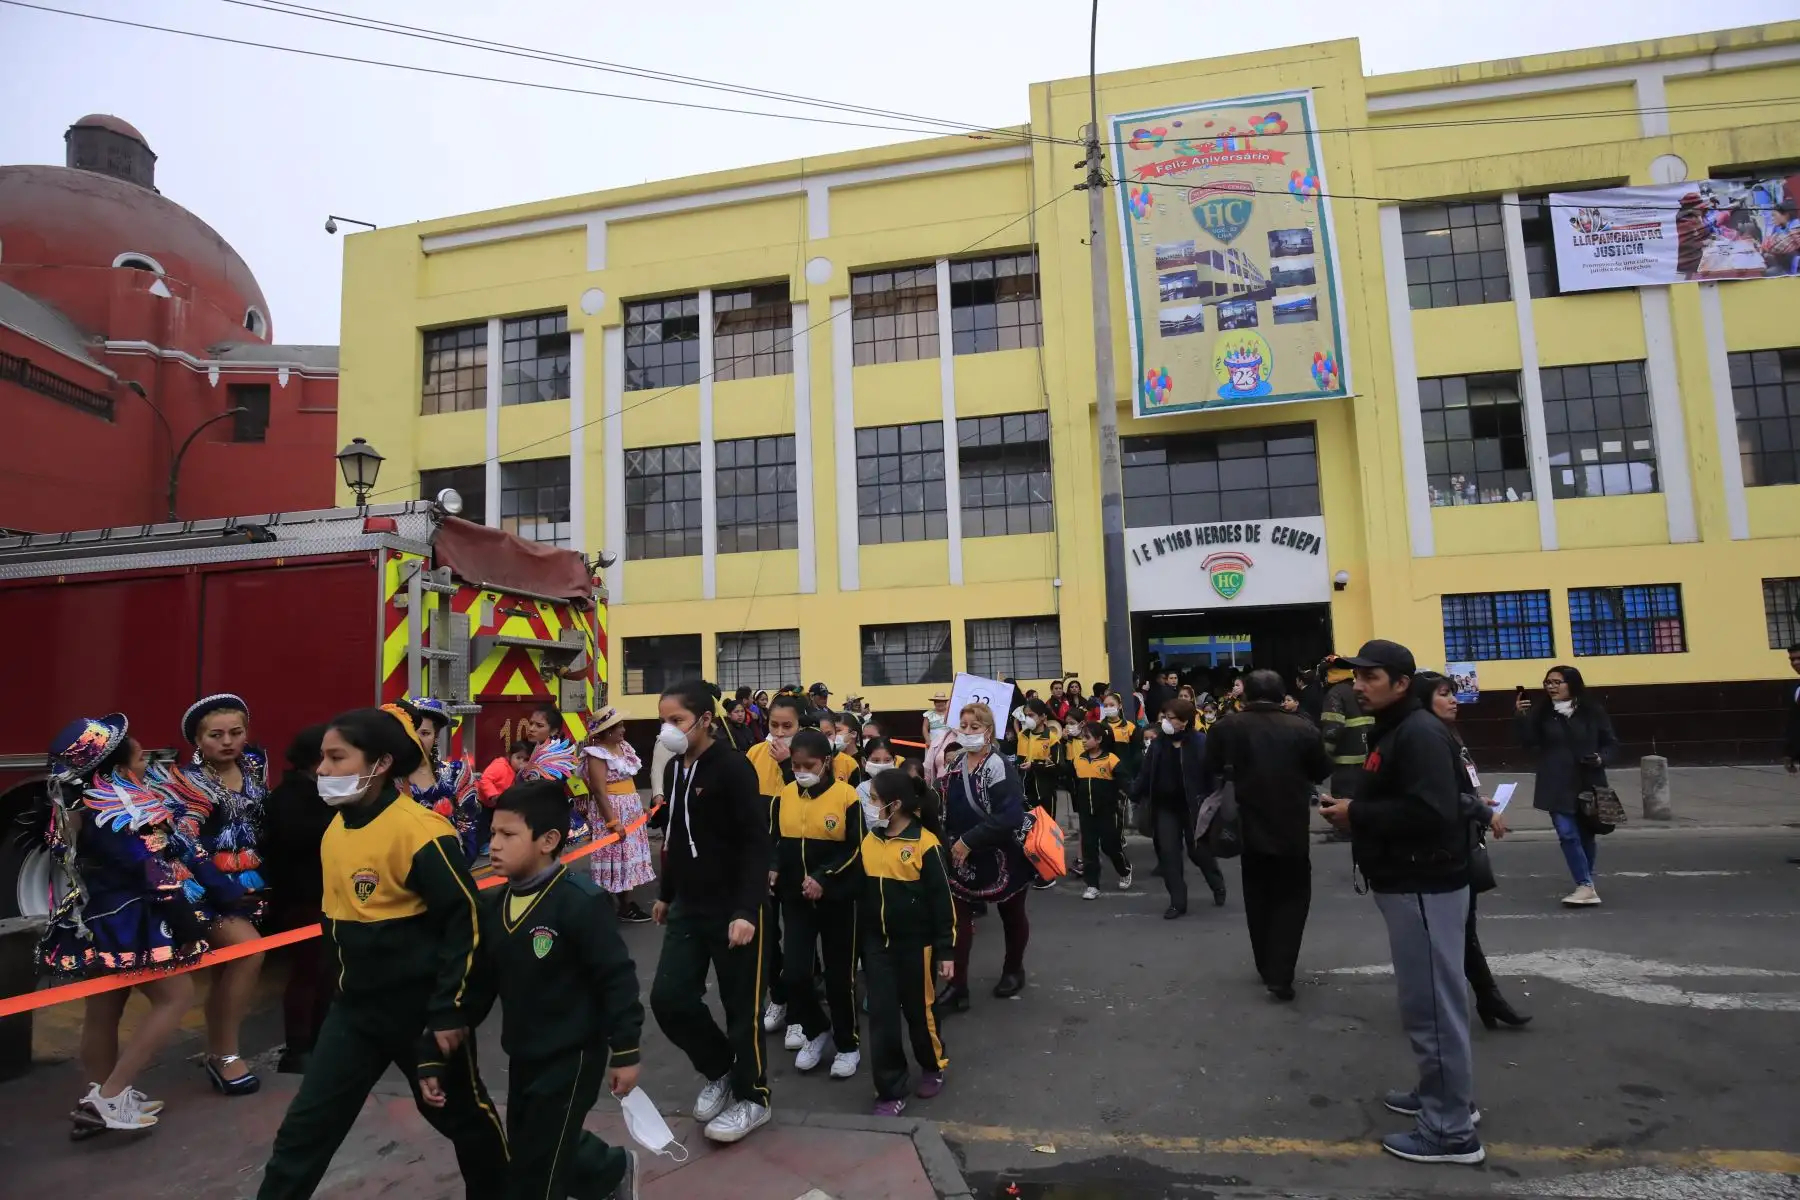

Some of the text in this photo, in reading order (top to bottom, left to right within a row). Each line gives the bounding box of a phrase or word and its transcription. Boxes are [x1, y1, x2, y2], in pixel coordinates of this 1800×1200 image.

[1156, 160, 1188, 173] Feliz
[1200, 201, 1246, 228] HC
[1593, 243, 1644, 257] JUSTICIA
[1234, 371, 1256, 386] 23
[1195, 524, 1242, 546] HEROES
[1245, 524, 1261, 543] DE
[1271, 526, 1321, 555] CENEPA
[1218, 574, 1240, 587] HC
[358, 882, 372, 894] HC
